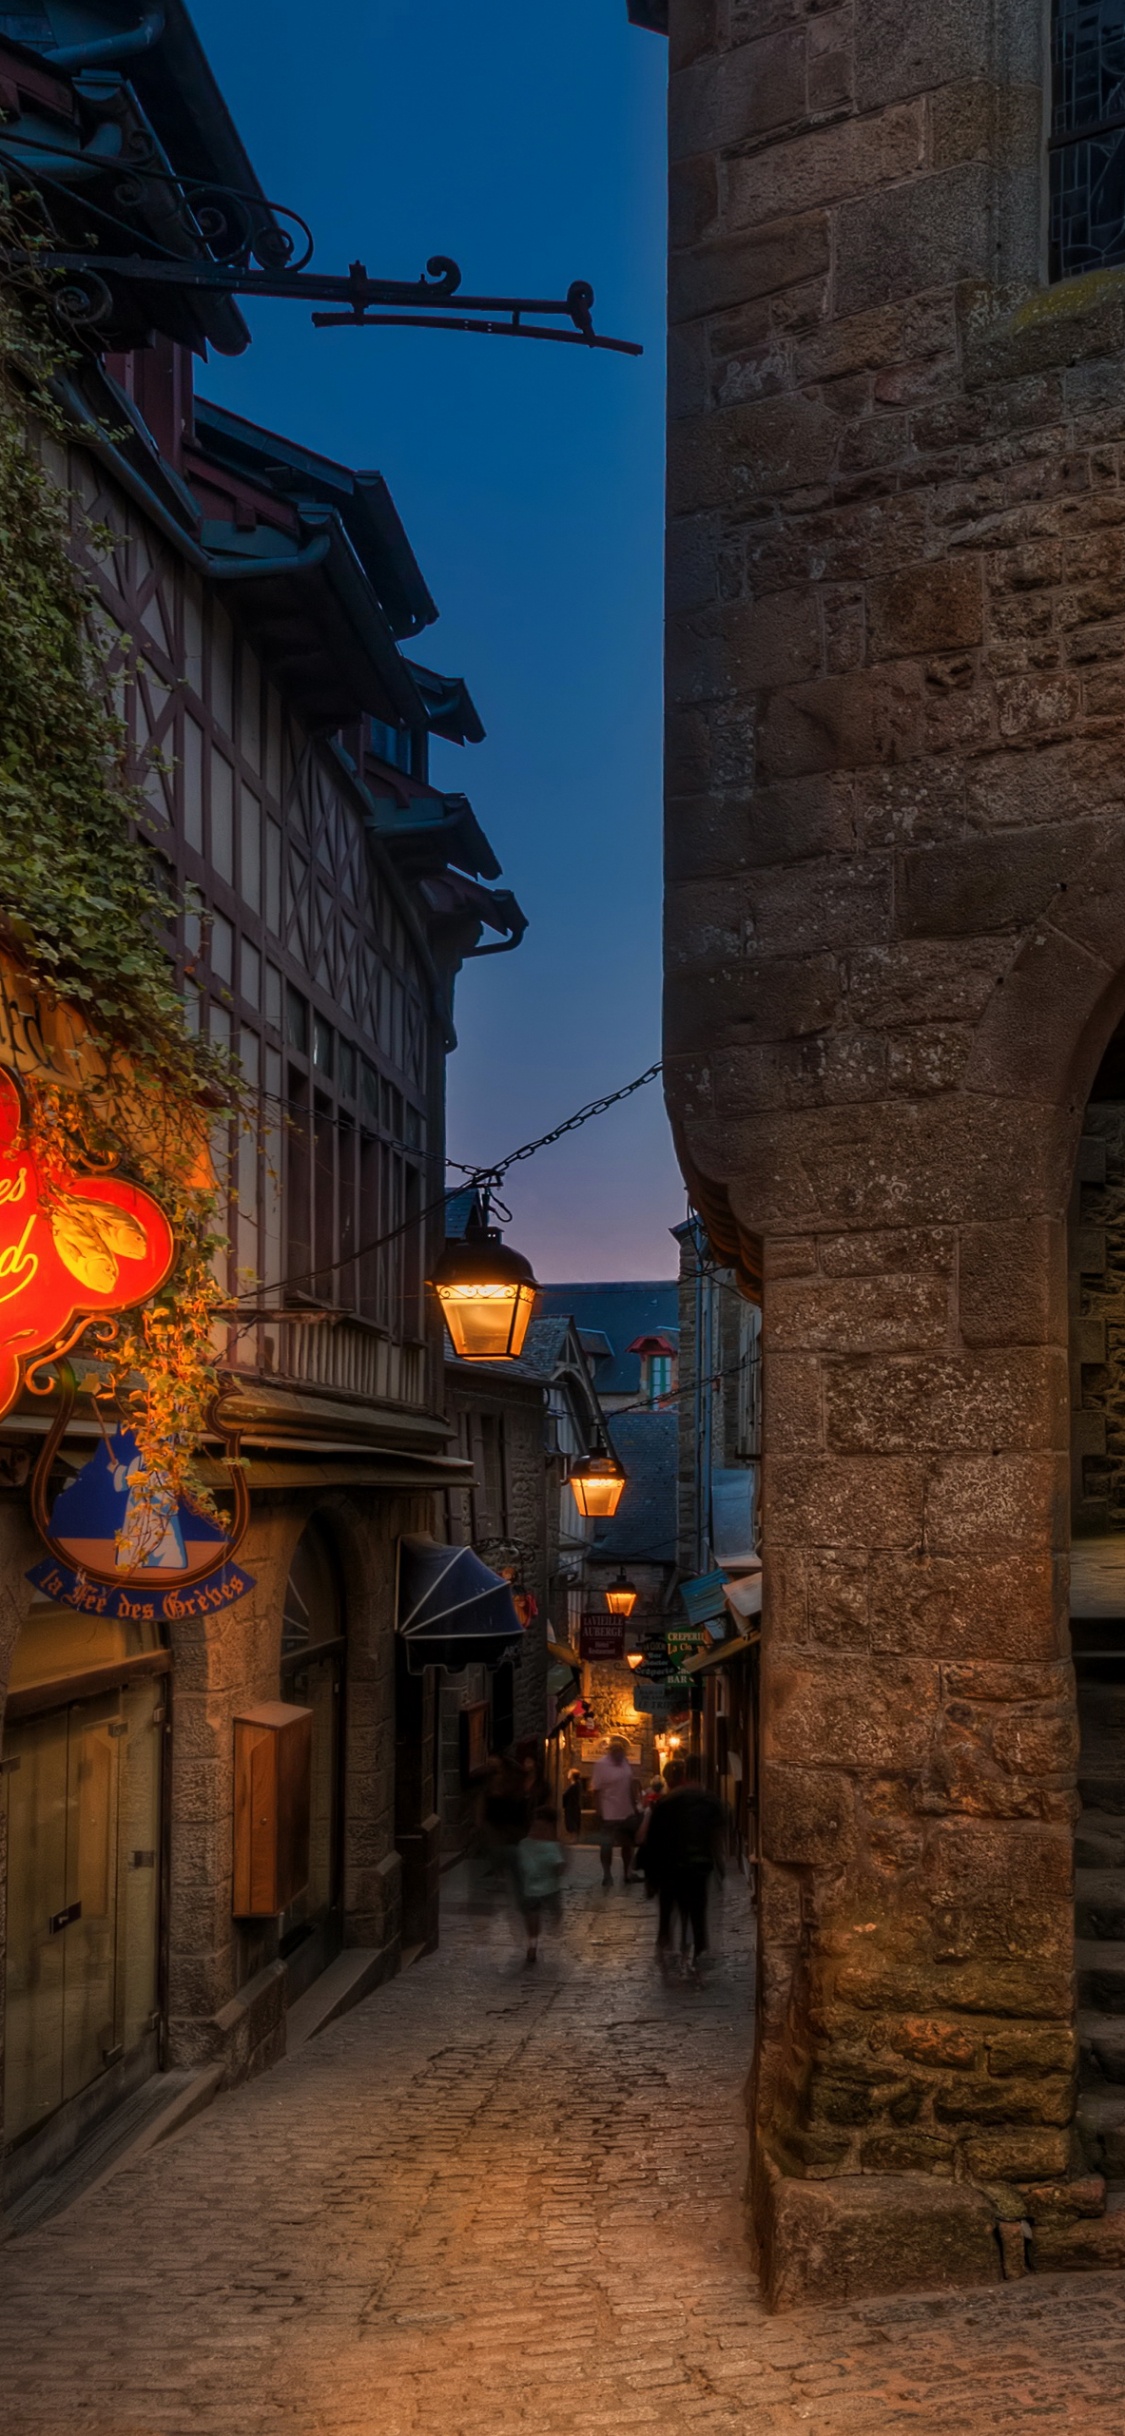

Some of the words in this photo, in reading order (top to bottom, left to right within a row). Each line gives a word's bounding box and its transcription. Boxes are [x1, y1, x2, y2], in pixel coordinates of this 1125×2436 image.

[117, 1593, 154, 1618] des
[162, 1575, 244, 1620] Grèves
[583, 1627, 623, 1636] AUBERGE
